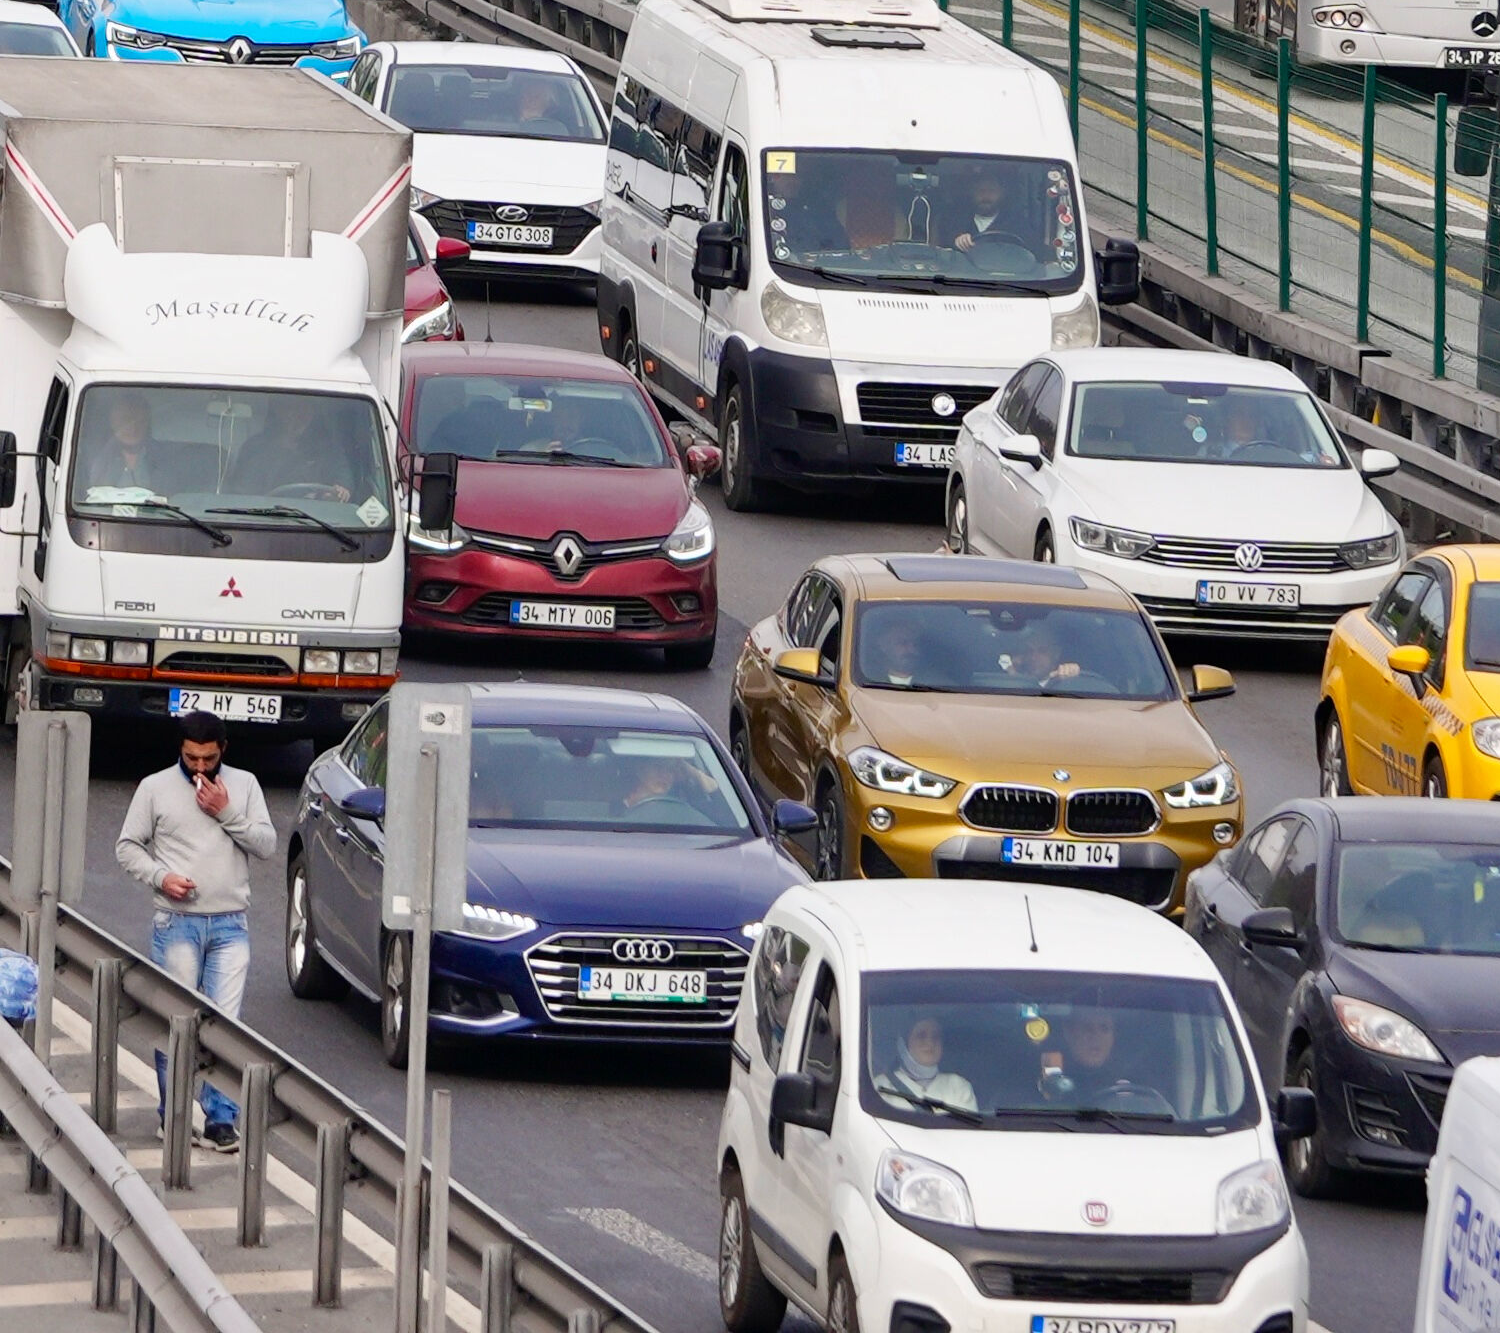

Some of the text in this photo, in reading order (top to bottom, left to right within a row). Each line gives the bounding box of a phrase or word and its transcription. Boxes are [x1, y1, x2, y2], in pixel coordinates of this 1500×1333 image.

[1448, 50, 1463, 65] 34
[775, 158, 788, 171] 7
[145, 297, 316, 333] Maşallah
[904, 445, 921, 461] 34
[1209, 585, 1297, 604] 10 VV 783
[280, 608, 346, 622] CANTER
[520, 605, 612, 627] 34 MTY 006
[158, 625, 300, 646] MITSUBISHI
[180, 692, 278, 716] 22 HY 546
[1013, 842, 1114, 864] 34 KMD 104
[591, 972, 701, 994] 34 DKJ 648
